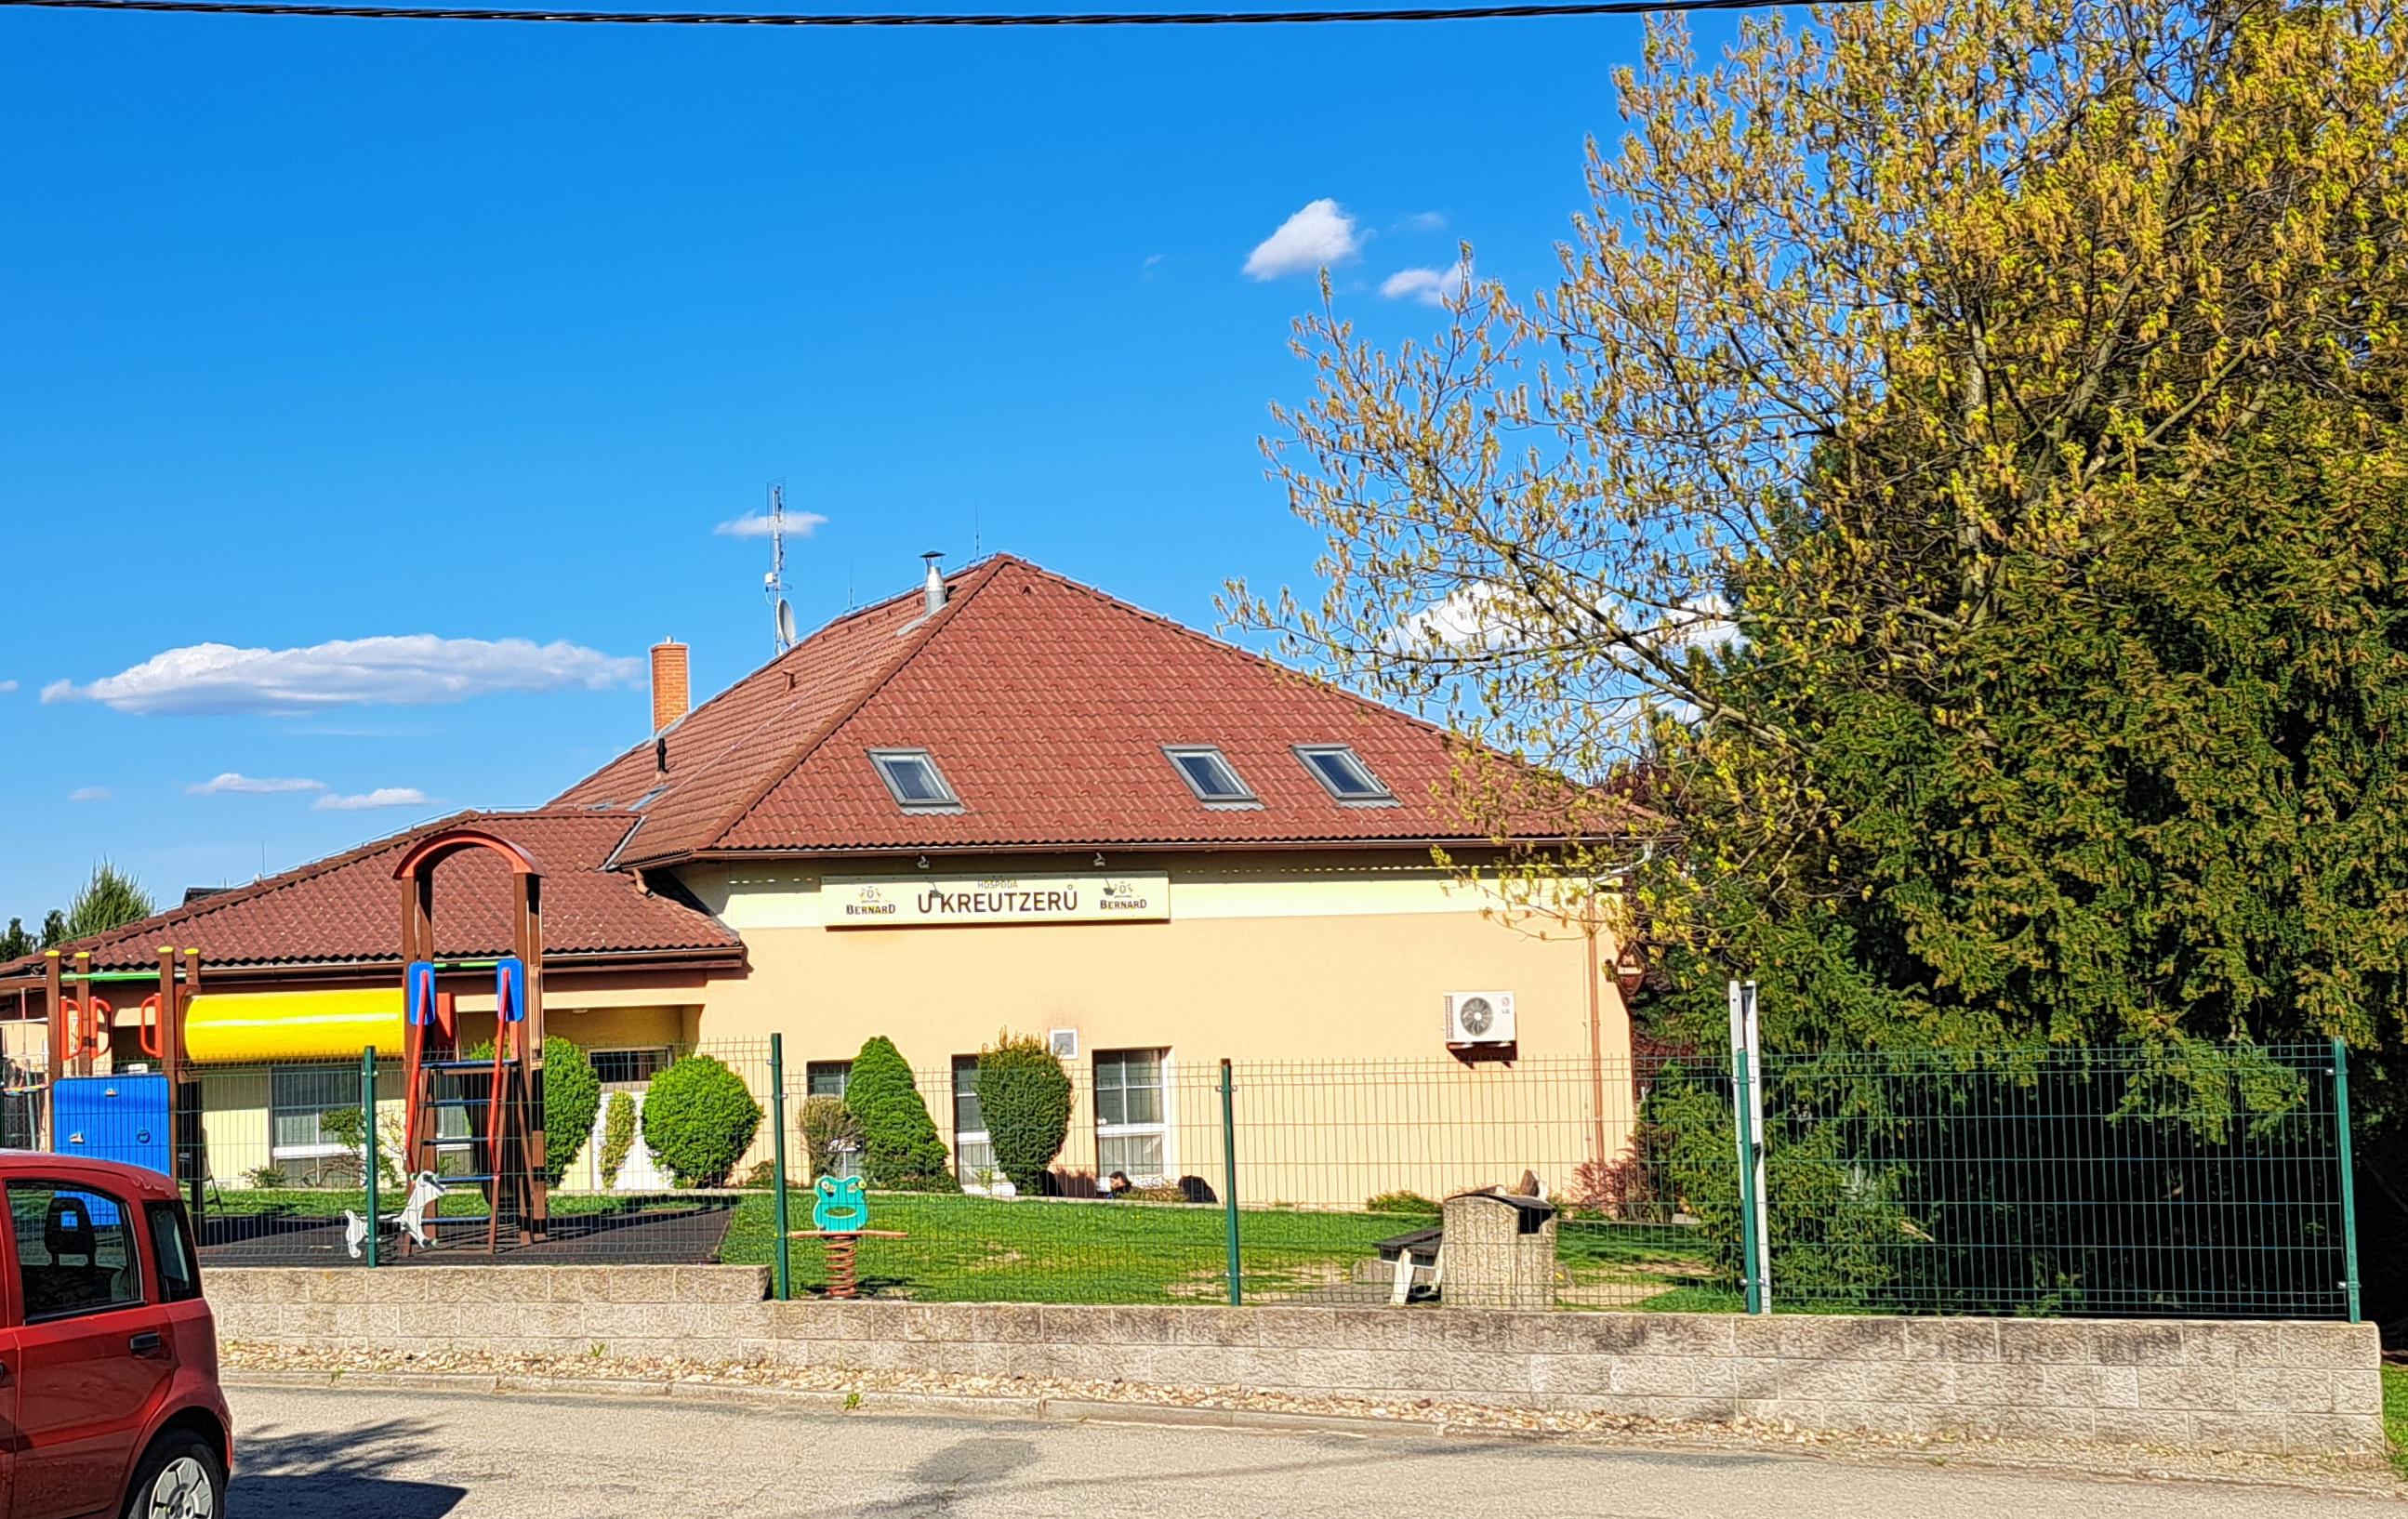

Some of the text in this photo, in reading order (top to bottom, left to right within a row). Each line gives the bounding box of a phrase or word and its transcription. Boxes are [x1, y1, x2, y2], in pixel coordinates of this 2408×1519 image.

[918, 884, 1078, 914] U KREUTZERŮ
[1100, 898, 1147, 910] BERNARD
[846, 904, 896, 915] BERNARD
